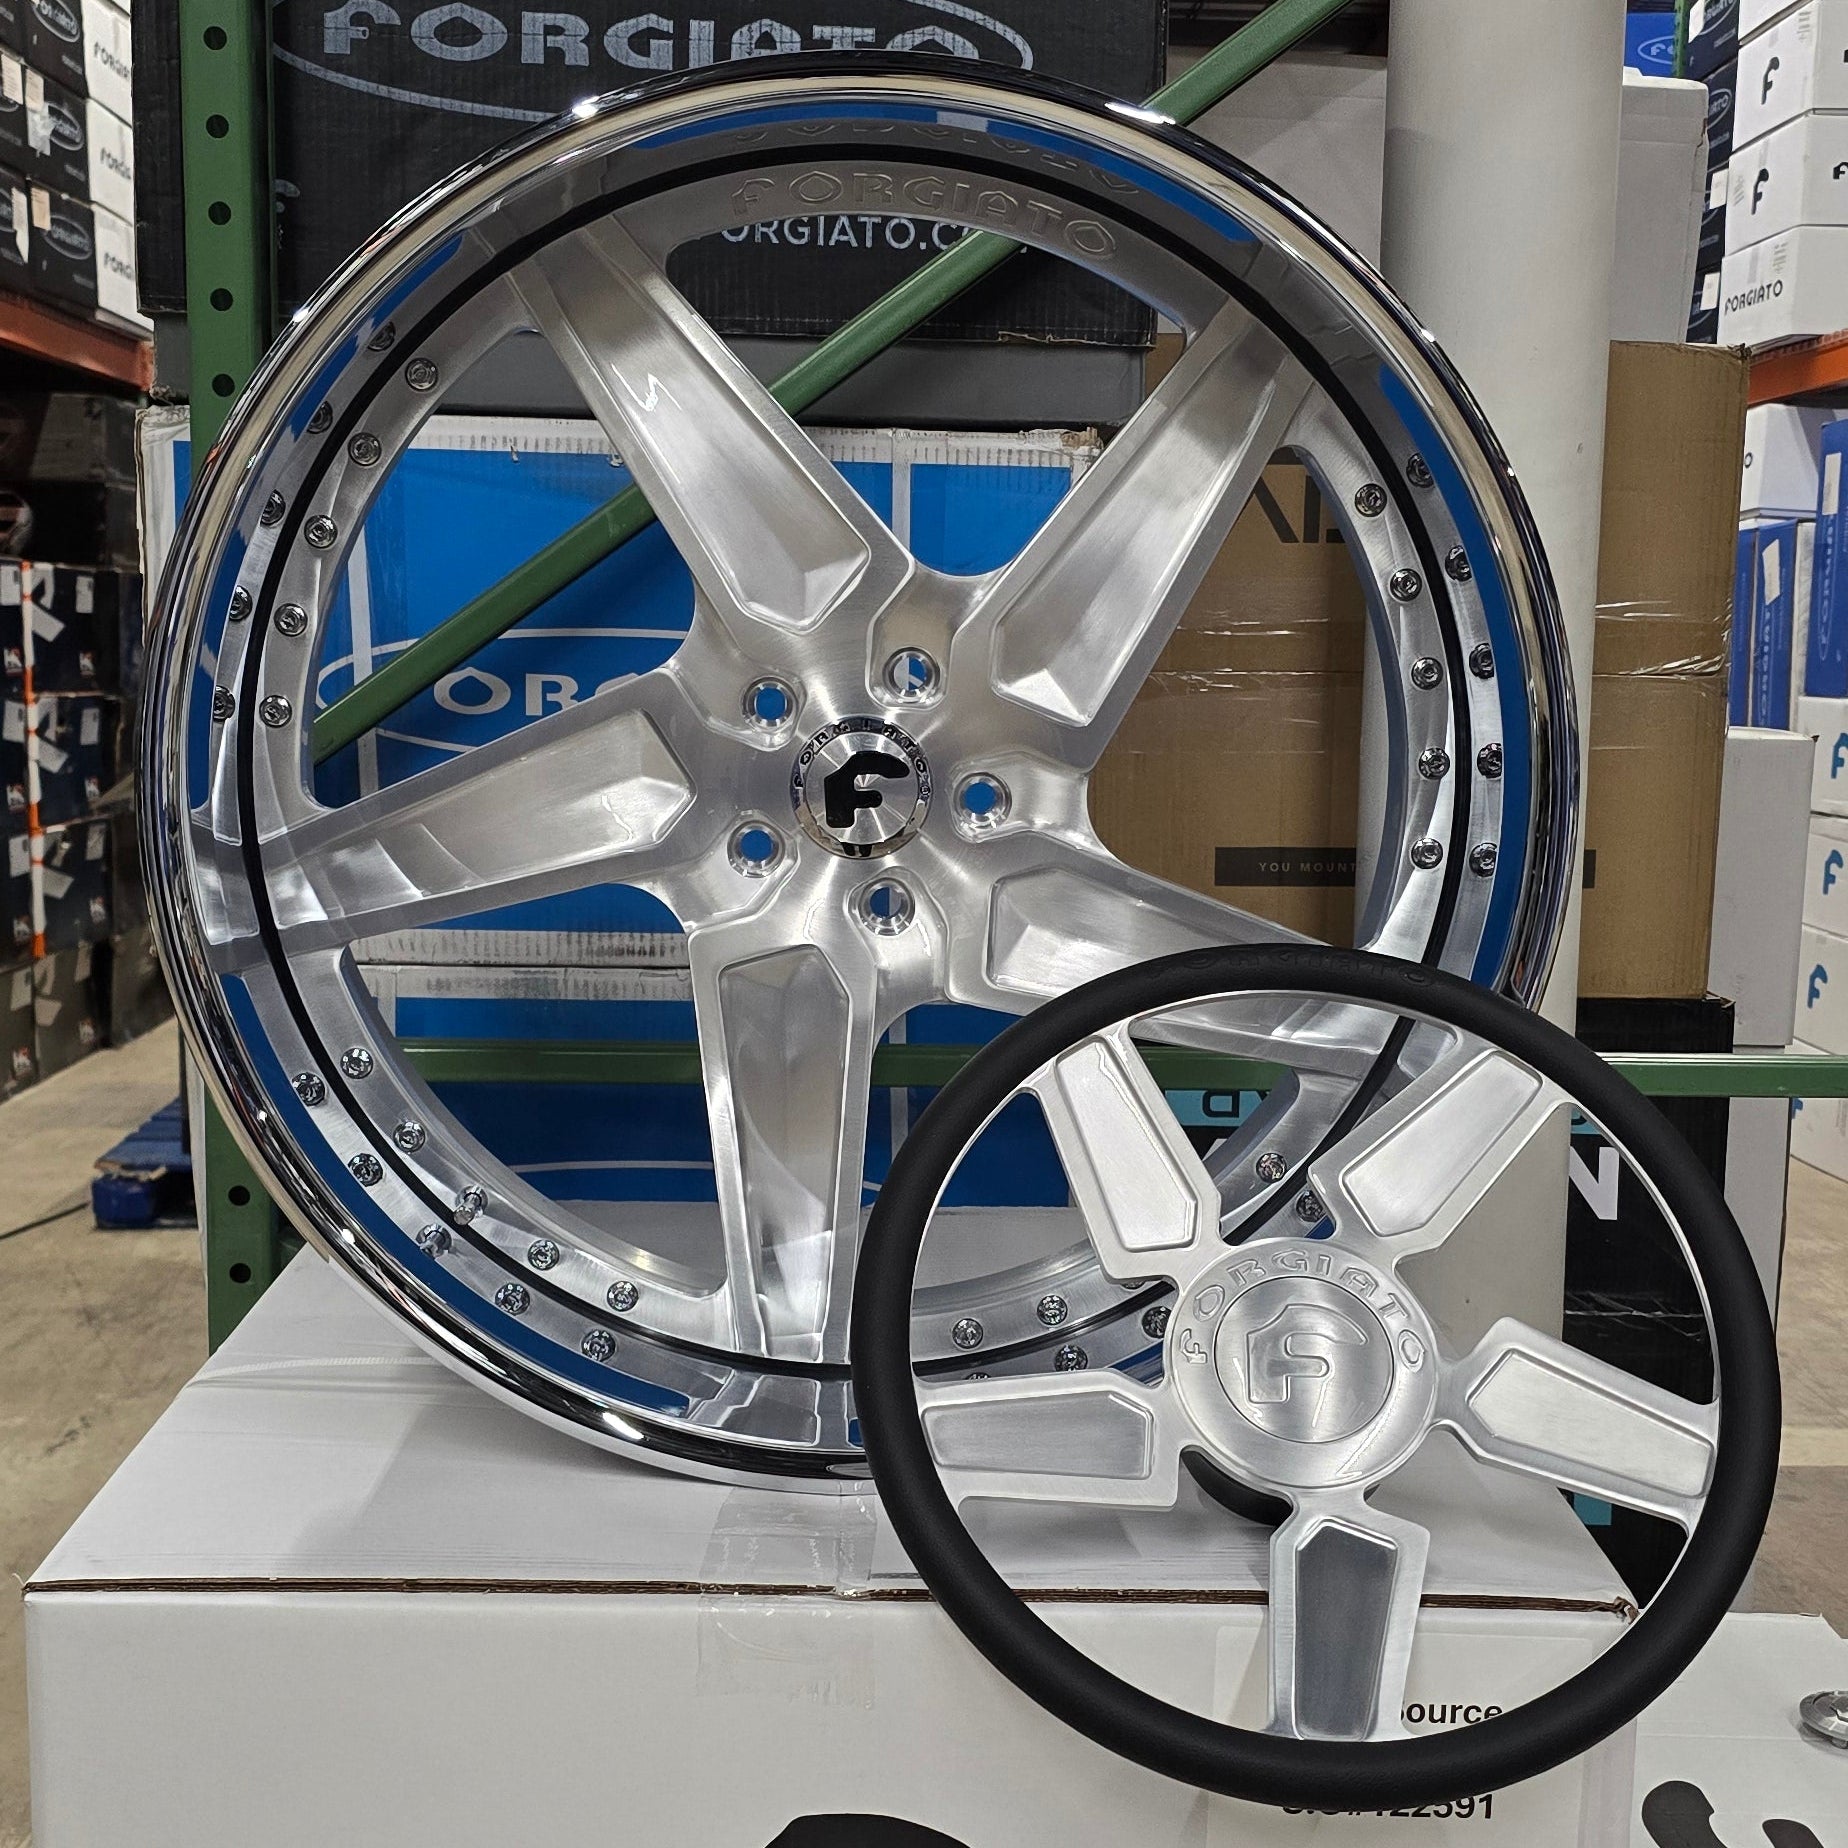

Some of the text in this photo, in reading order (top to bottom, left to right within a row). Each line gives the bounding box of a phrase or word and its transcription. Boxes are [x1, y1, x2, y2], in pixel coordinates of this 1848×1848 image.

[731, 171, 1118, 259] FORGIATO
[1725, 279, 1783, 316] FORGIATO
[1258, 862, 1291, 873] YOU
[1179, 1248, 1425, 1374] FORGIATO
[1401, 1703, 1502, 1724] ource
